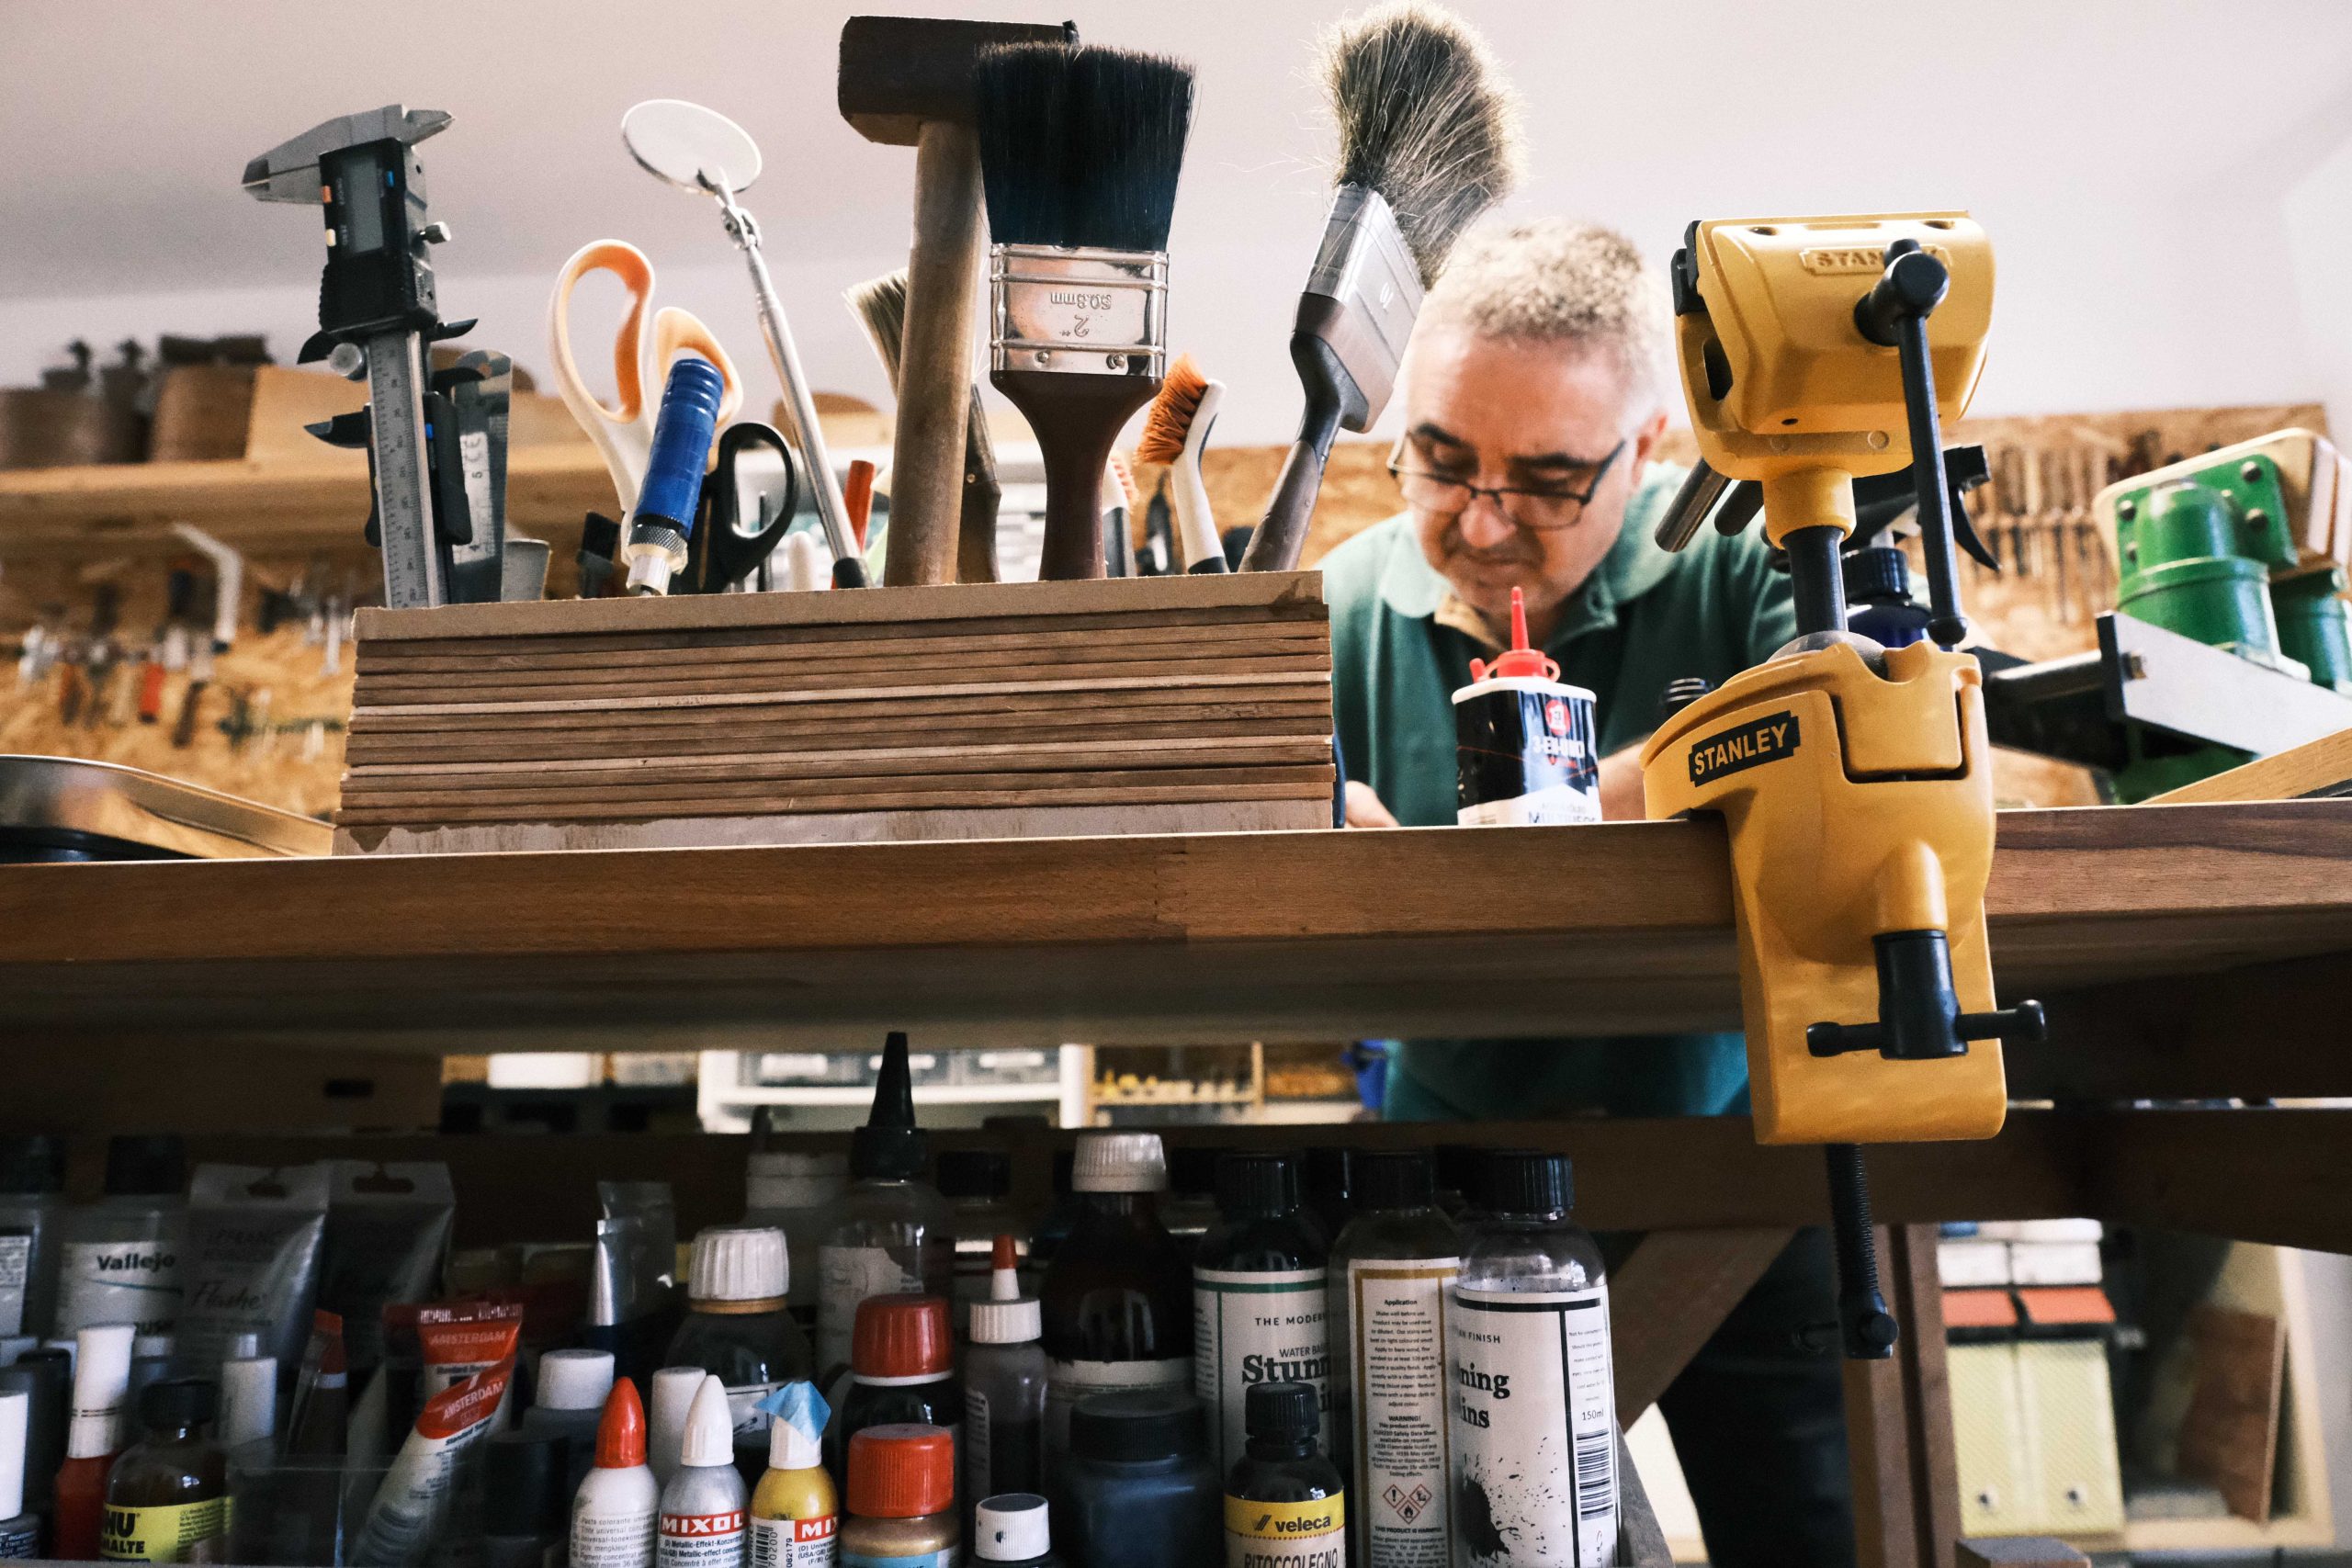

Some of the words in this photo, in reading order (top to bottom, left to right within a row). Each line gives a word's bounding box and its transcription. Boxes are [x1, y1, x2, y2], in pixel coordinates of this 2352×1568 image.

[1694, 722, 1788, 775] STANLEY
[96, 1251, 176, 1272] Vallejo
[1384, 1299, 1418, 1307] Application
[1255, 1317, 1280, 1326] THE
[429, 1330, 506, 1346] AMSTERDAM
[1468, 1332, 1500, 1344] FINISH
[1279, 1347, 1311, 1358] WATER
[442, 1381, 503, 1422] AMSTERDAM
[1581, 1407, 1604, 1421] 150ml
[662, 1513, 743, 1533] MIXOL
[1274, 1515, 1331, 1533] veleca
[679, 1549, 721, 1558] Metallic-effect
[797, 1544, 808, 1552] (D)
